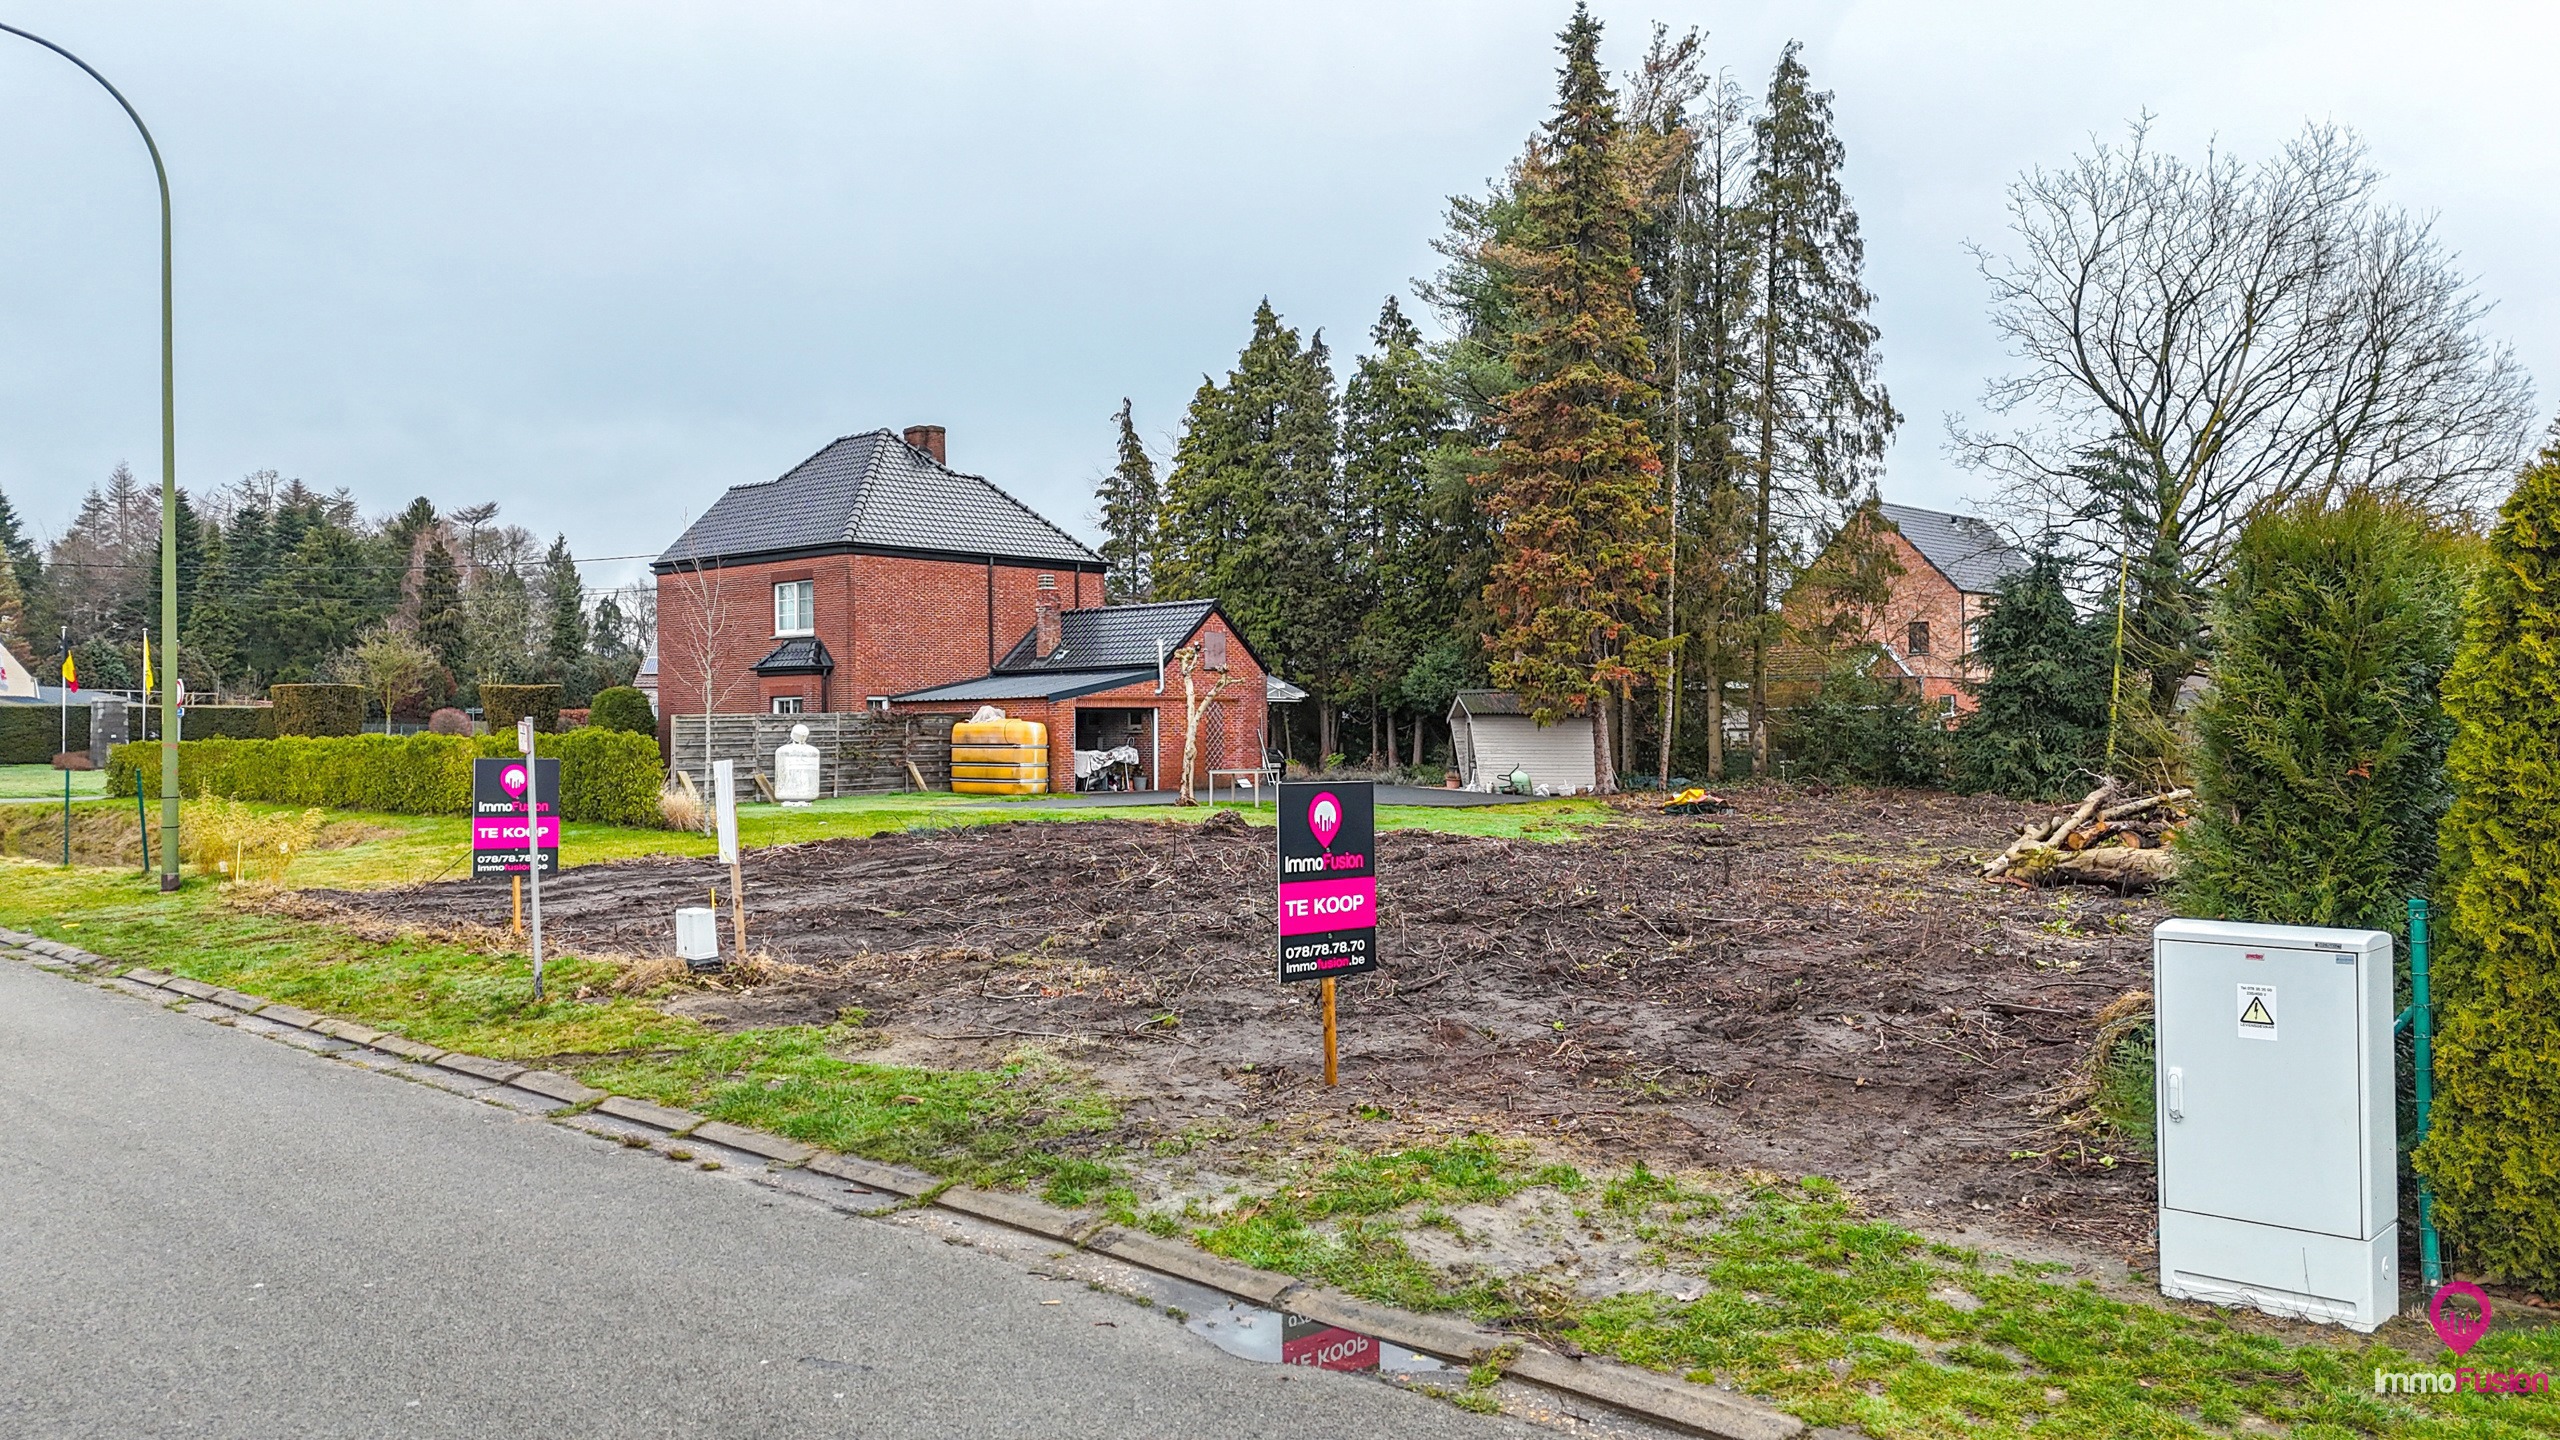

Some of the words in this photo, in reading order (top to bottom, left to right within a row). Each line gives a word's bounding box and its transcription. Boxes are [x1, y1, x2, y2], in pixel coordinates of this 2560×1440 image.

[478, 801, 549, 812] ImmoFuon
[478, 827, 499, 838] TE
[477, 854, 549, 864] 078/78.7870
[1284, 852, 1364, 873] ImmoFusion
[1285, 899, 1309, 917] TE
[1313, 894, 1364, 915] KOOP
[1285, 939, 1366, 959] 078/78.78.70
